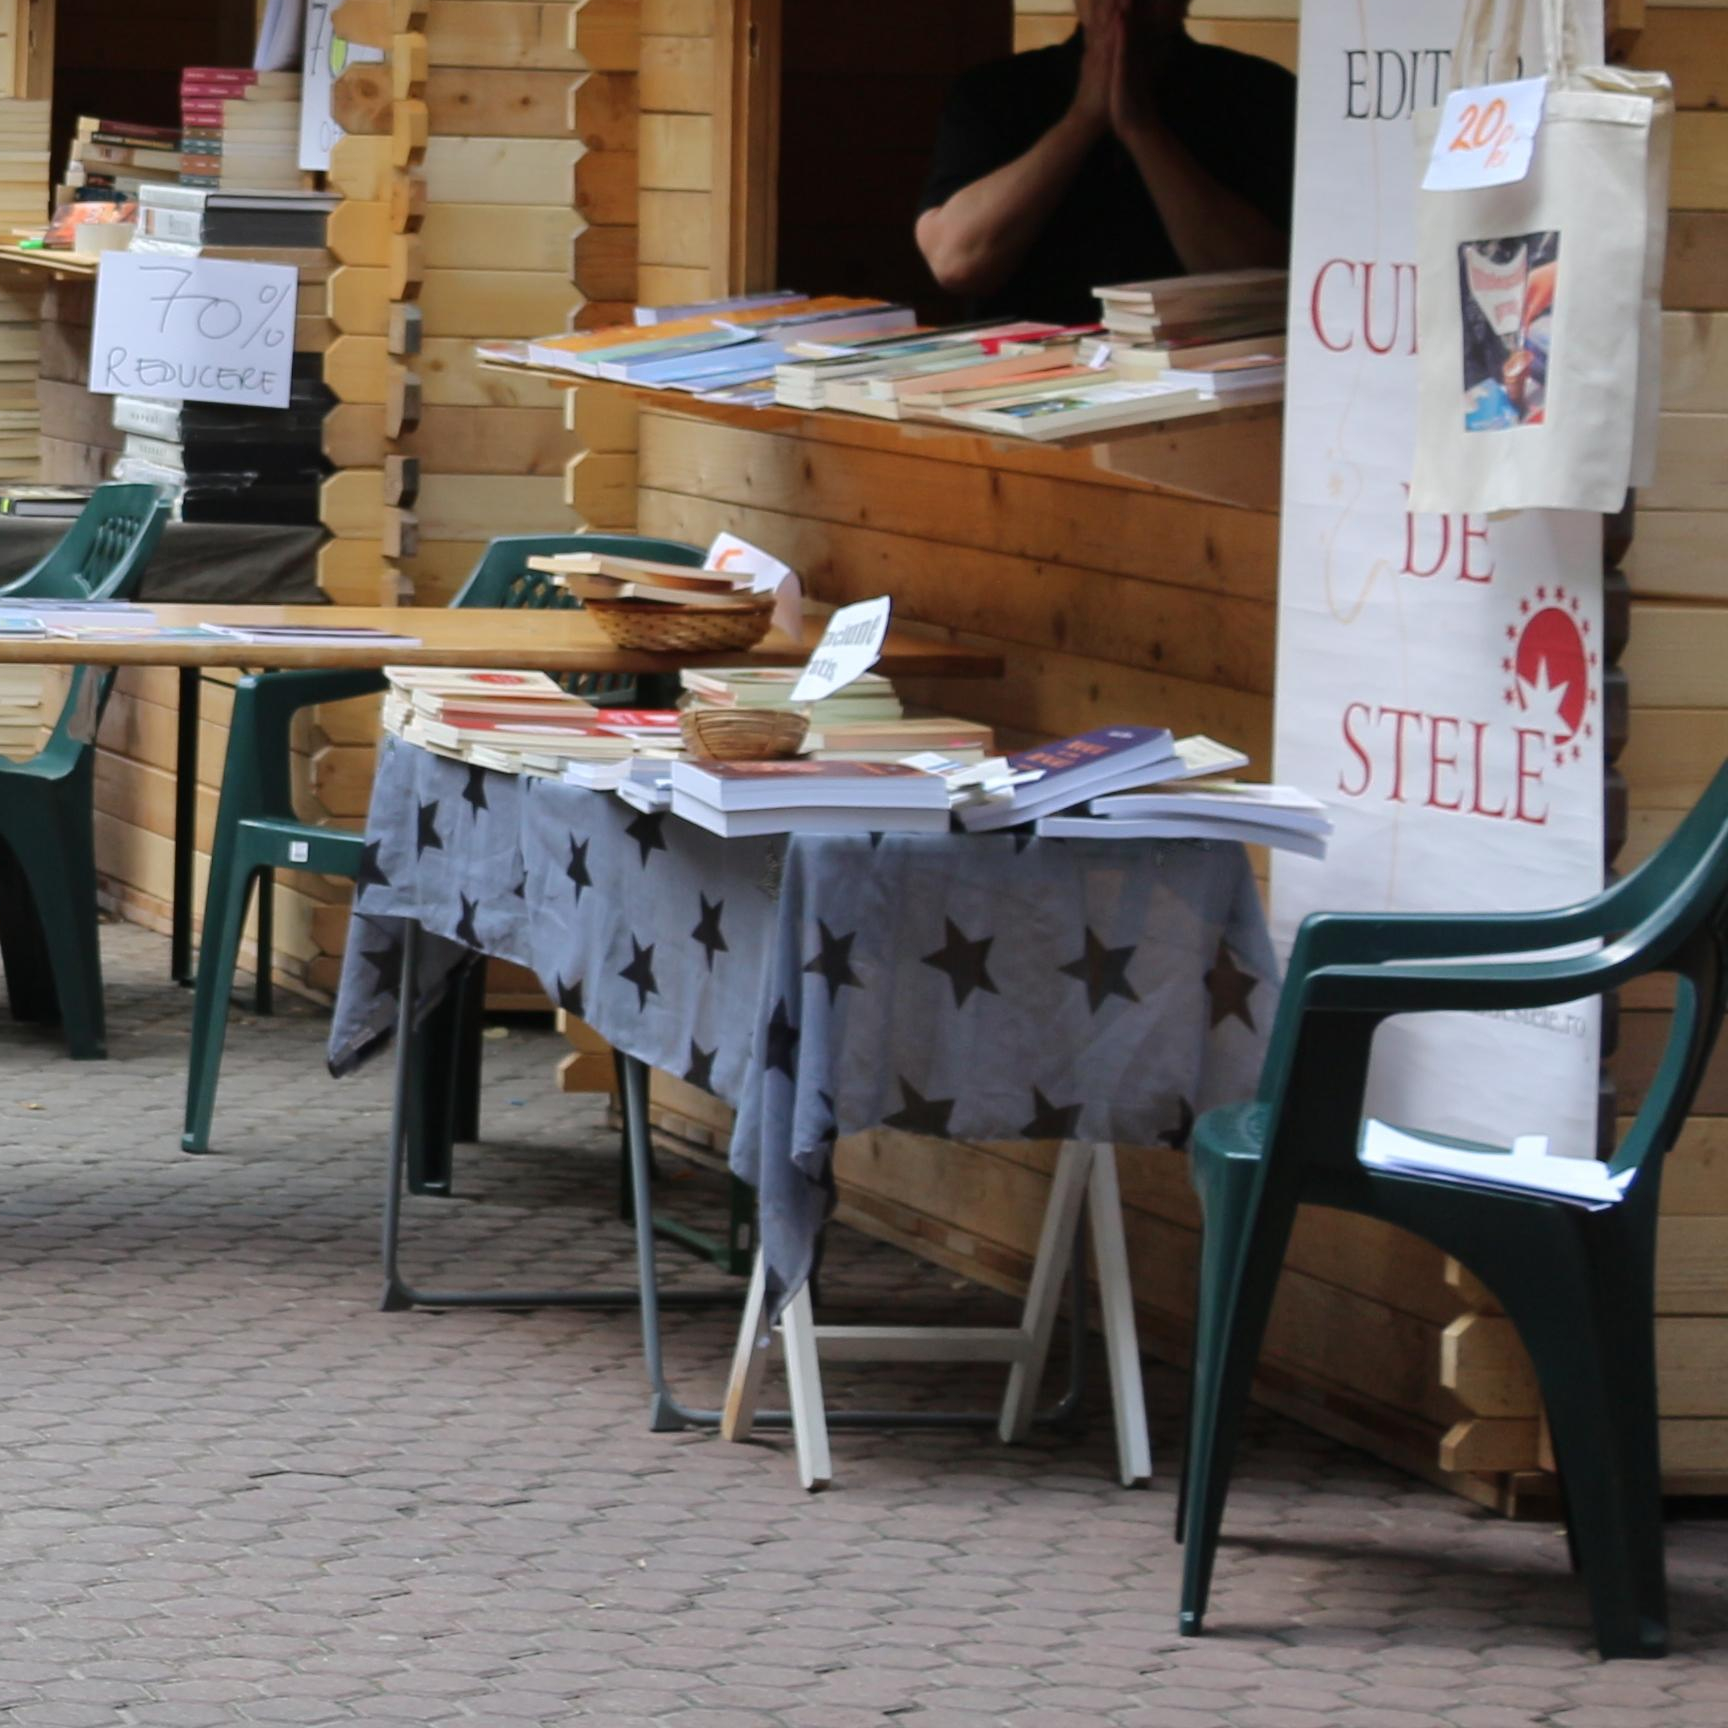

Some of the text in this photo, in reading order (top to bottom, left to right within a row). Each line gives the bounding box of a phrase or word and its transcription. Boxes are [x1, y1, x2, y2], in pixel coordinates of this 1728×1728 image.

[1448, 97, 1507, 152] 20
[138, 265, 293, 350] 70%
[105, 346, 277, 395] REDUCERE
[1400, 482, 1495, 584] DE
[1337, 701, 1549, 826] STELE
